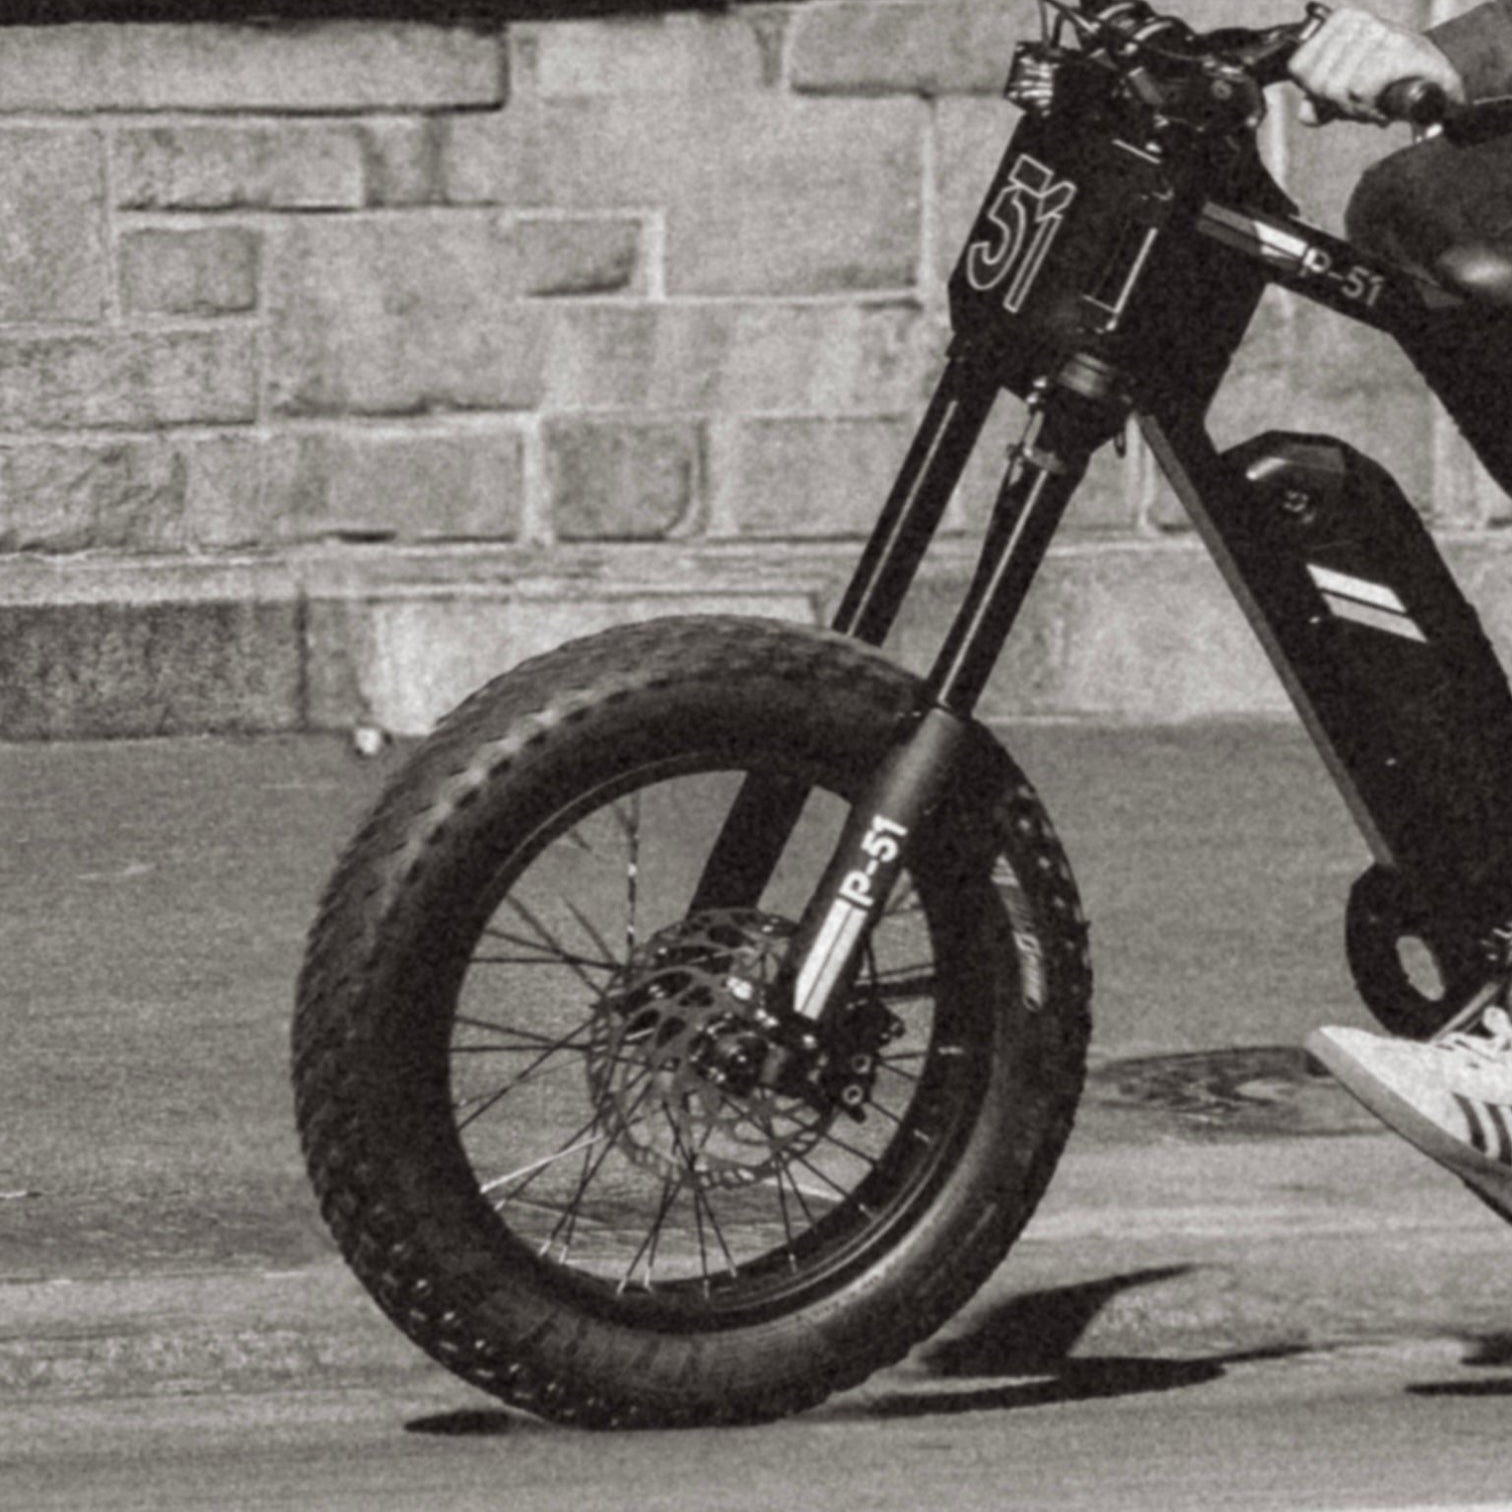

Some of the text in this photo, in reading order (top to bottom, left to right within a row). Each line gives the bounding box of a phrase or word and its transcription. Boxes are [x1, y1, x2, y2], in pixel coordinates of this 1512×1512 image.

[966, 153, 1077, 314] 51
[1299, 247, 1384, 307] P-51
[839, 814, 908, 907] P-51
